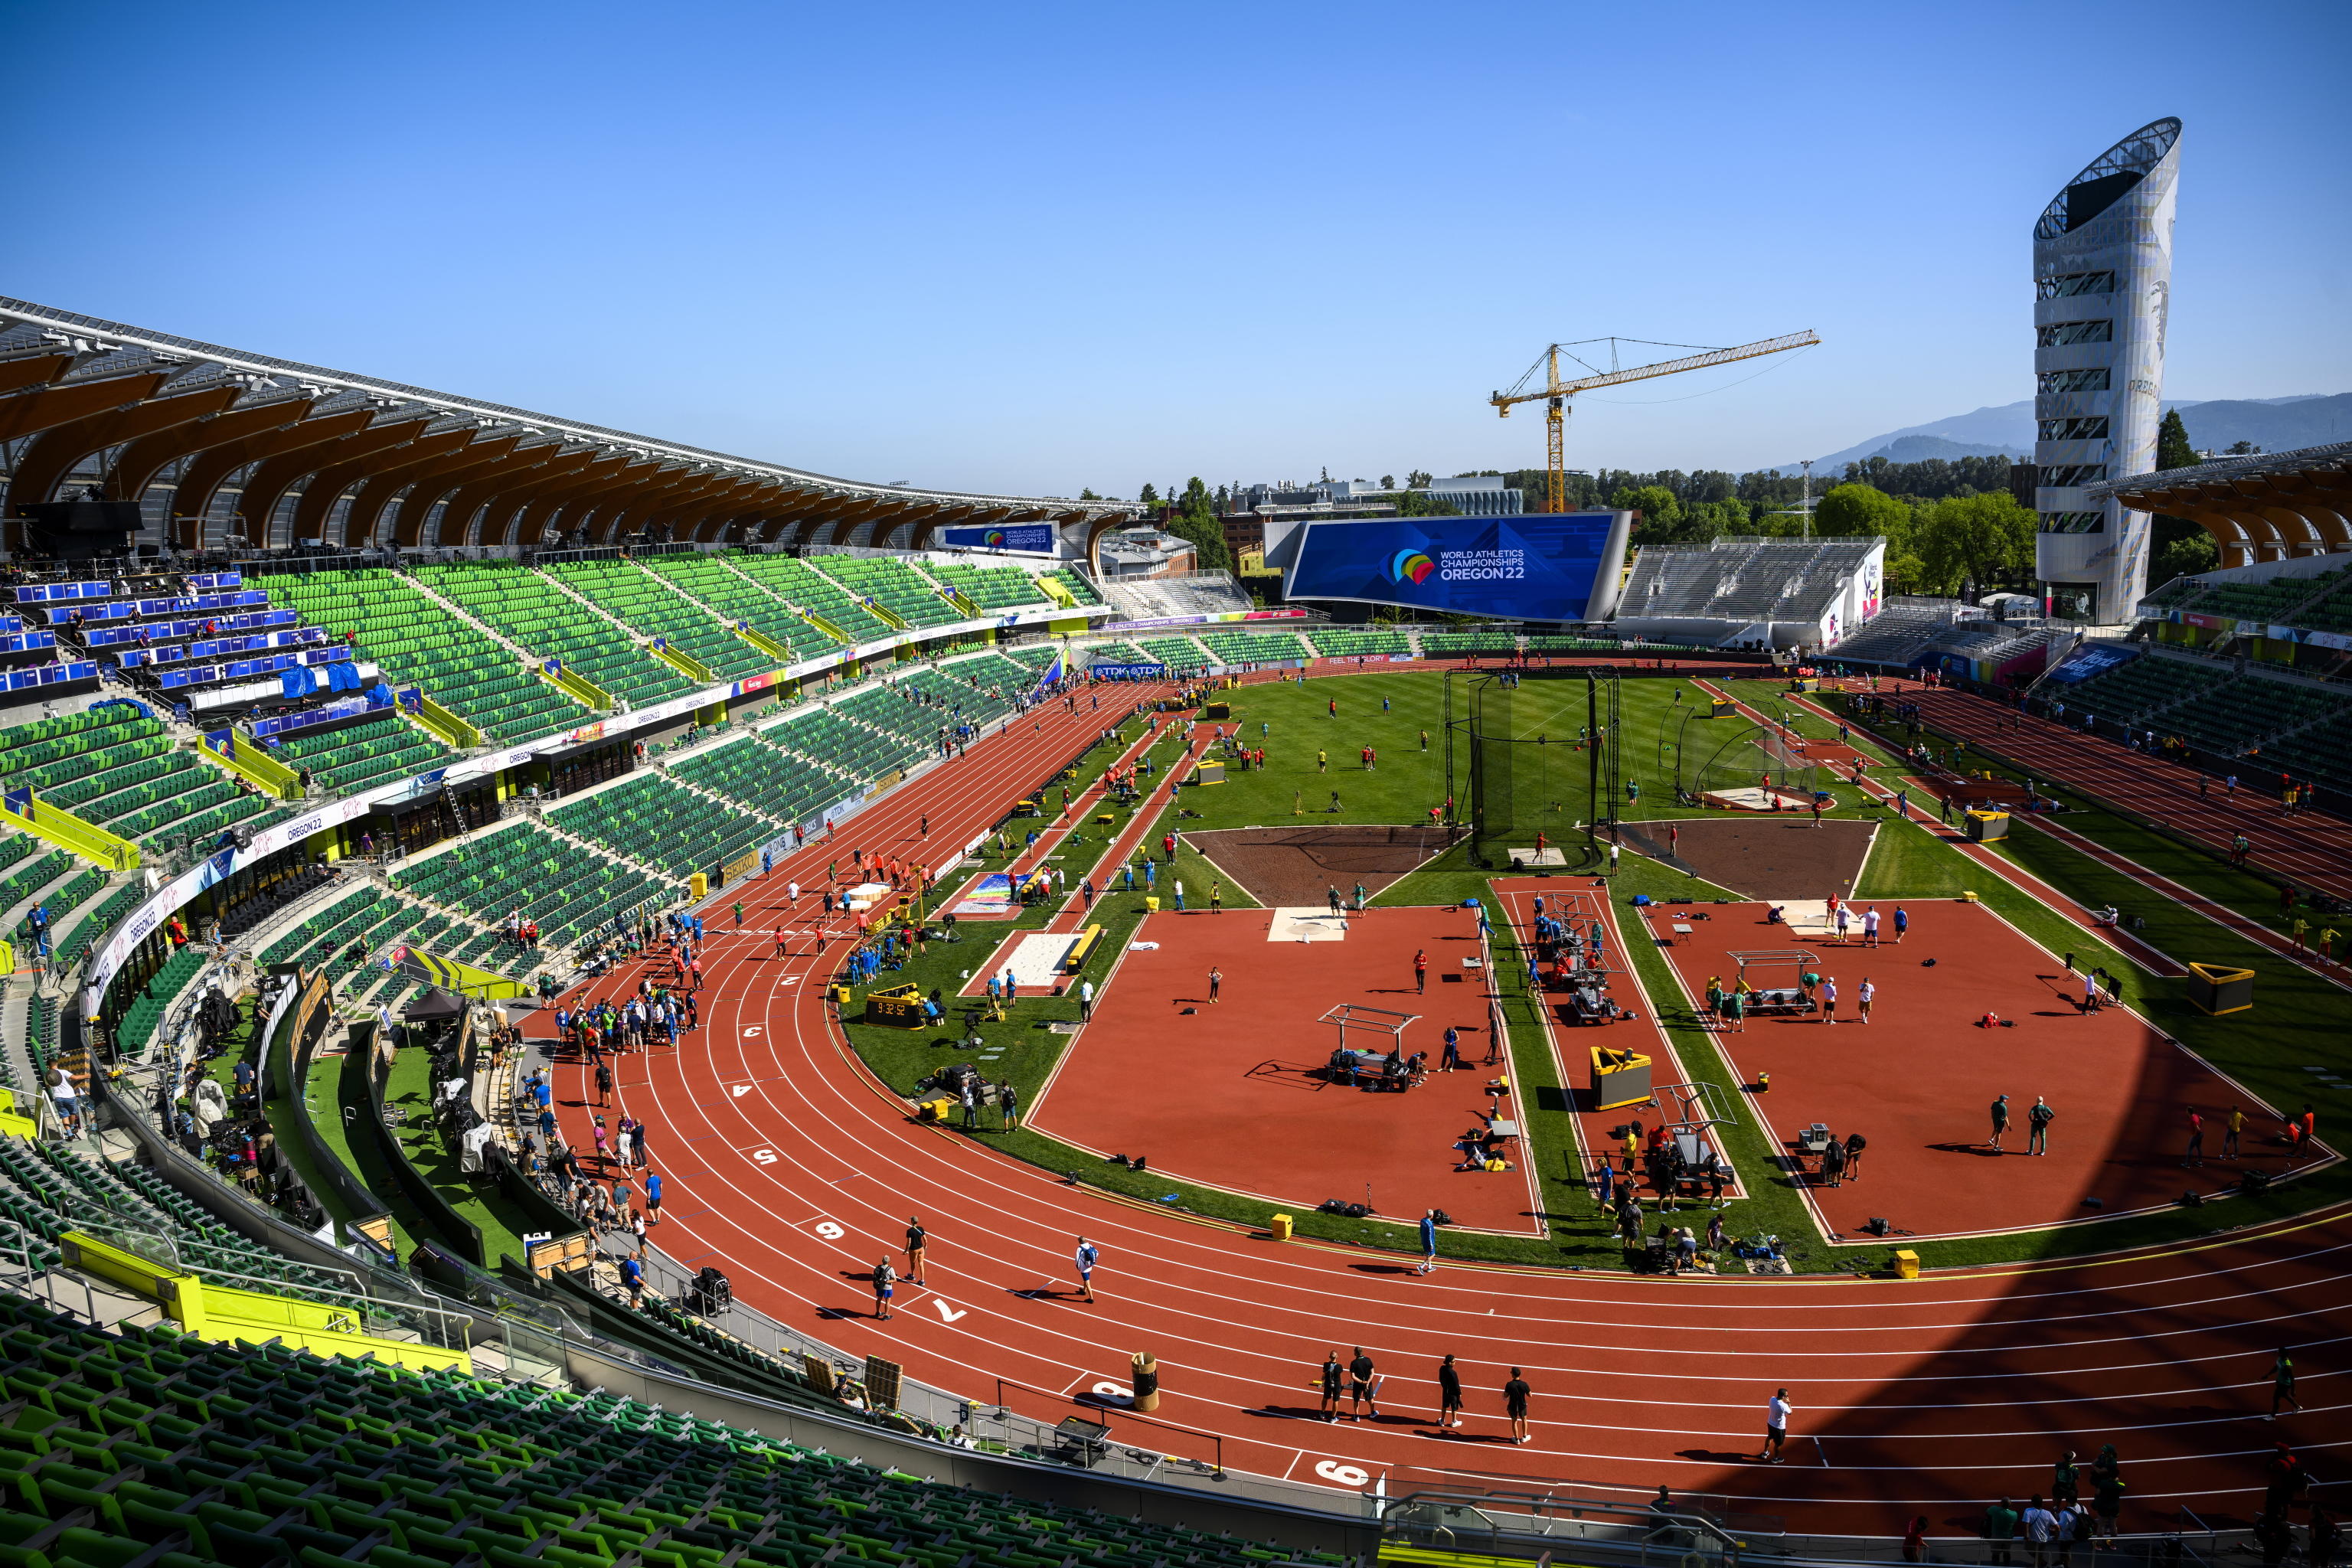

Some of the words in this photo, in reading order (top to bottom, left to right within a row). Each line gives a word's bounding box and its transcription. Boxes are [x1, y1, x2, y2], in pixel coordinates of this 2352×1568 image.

[1440, 550, 1473, 559] WORLD
[1475, 550, 1524, 558] ATHLETICS
[1440, 557, 1524, 567] CHAMPIONSHIPS
[1102, 667, 1128, 675] TDK
[1138, 666, 1162, 675] TDK
[879, 773, 897, 792] SEIKO
[805, 818, 817, 835] asics
[773, 836, 786, 851] QNB
[725, 854, 754, 881] SEIKO
[781, 976, 800, 985] 2
[878, 1002, 905, 1016] 9:32:52
[743, 1027, 763, 1037] 3
[1632, 1060, 1651, 1068] SEIKO
[733, 1085, 753, 1097] 4
[753, 1149, 778, 1165] 5
[815, 1221, 845, 1240] 6
[933, 1298, 968, 1322] 7
[1092, 1381, 1135, 1406] 8
